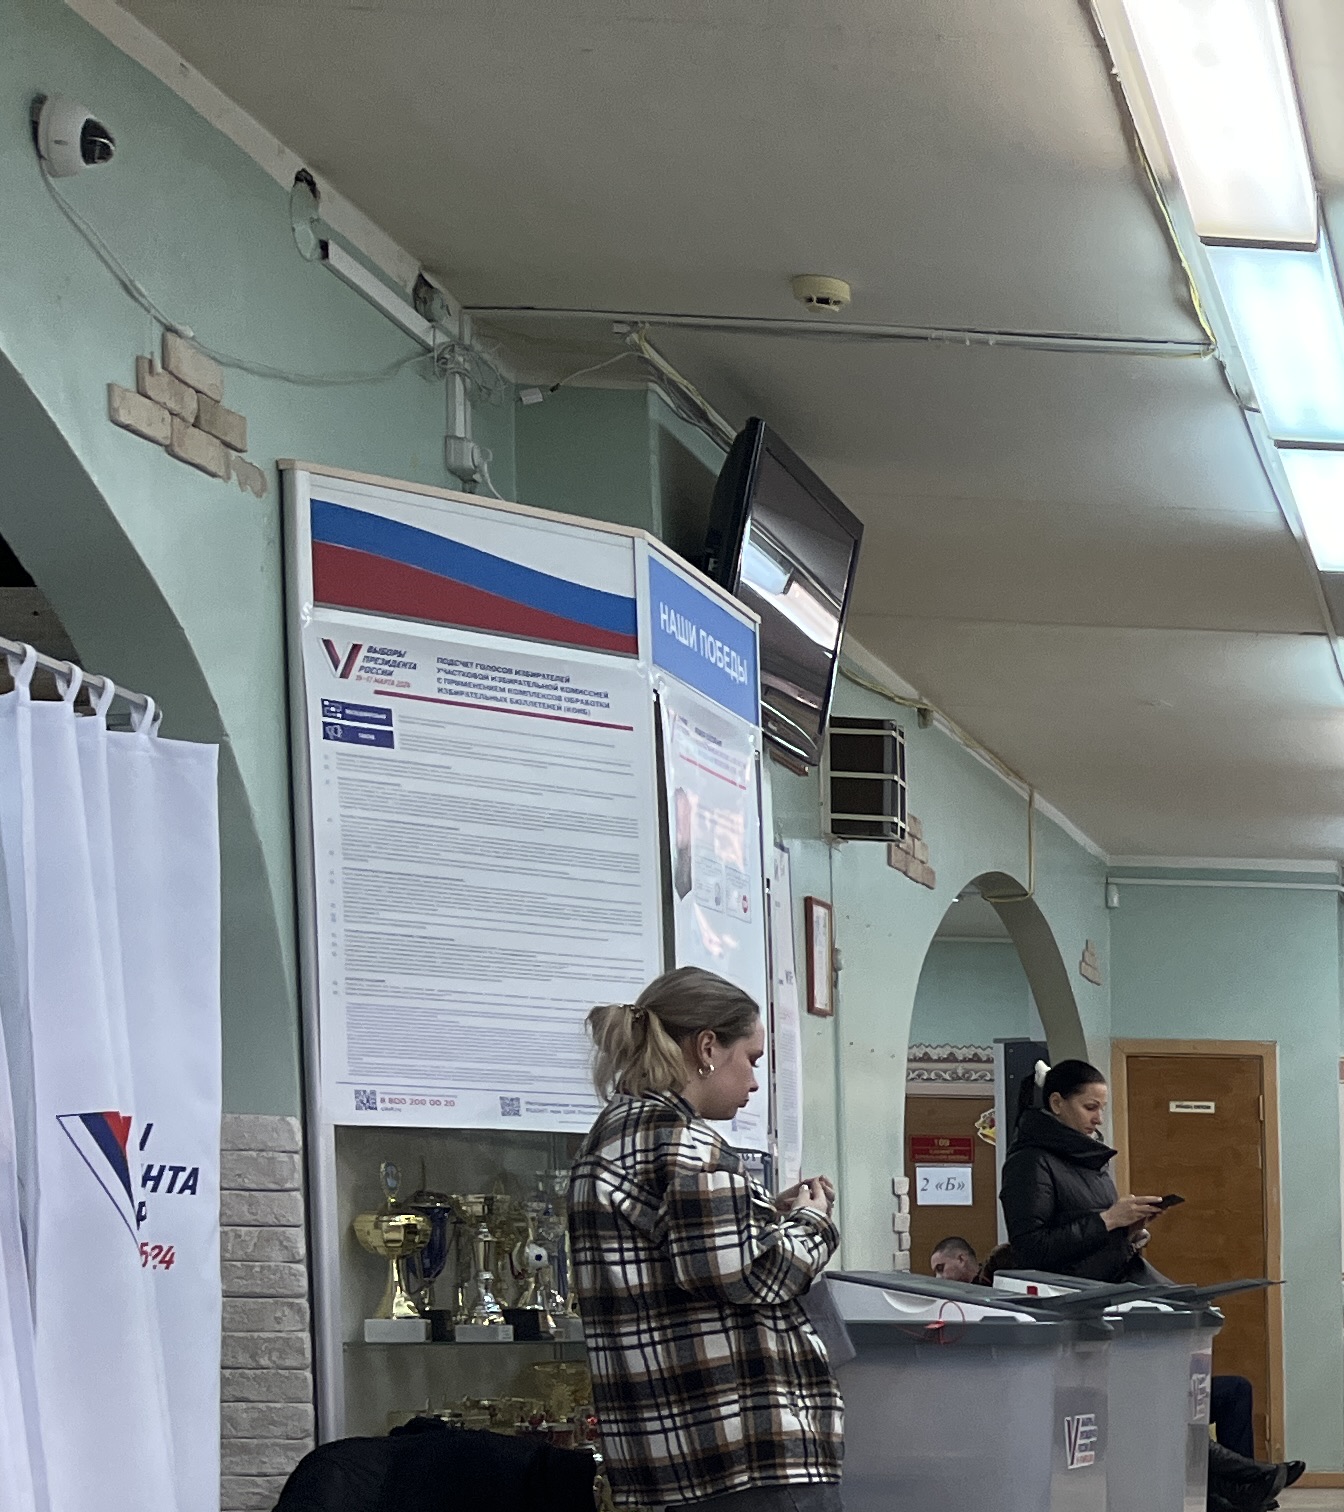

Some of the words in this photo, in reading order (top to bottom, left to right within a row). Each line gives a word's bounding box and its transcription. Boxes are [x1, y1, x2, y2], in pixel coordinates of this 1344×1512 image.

[660, 602, 697, 652] НАШИ
[700, 629, 748, 685] ПОБЕДЫ
[921, 1177, 929, 1192] 2
[935, 1177, 965, 1191] «Б»
